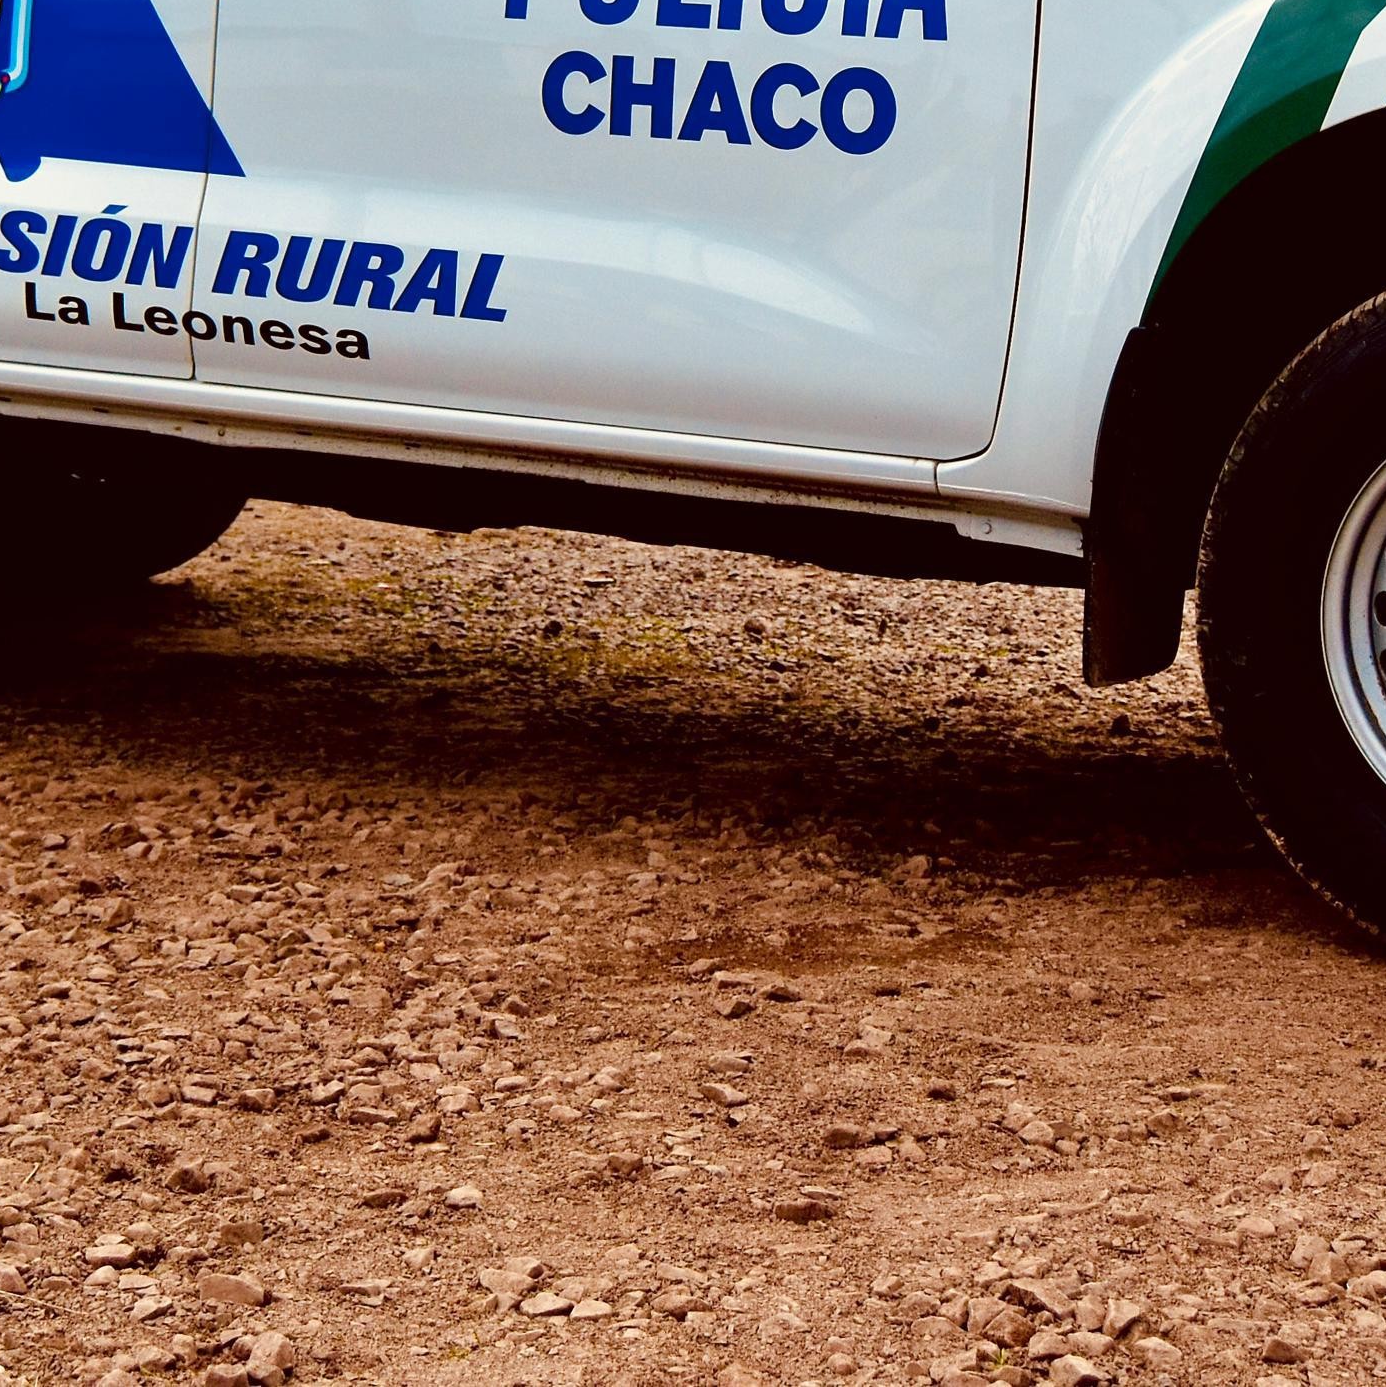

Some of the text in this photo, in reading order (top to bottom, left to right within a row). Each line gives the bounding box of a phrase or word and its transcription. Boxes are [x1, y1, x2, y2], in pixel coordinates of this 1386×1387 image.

[541, 50, 898, 155] CHACO
[24, 281, 371, 360] La Leonesa
[211, 230, 509, 323] RURAL
